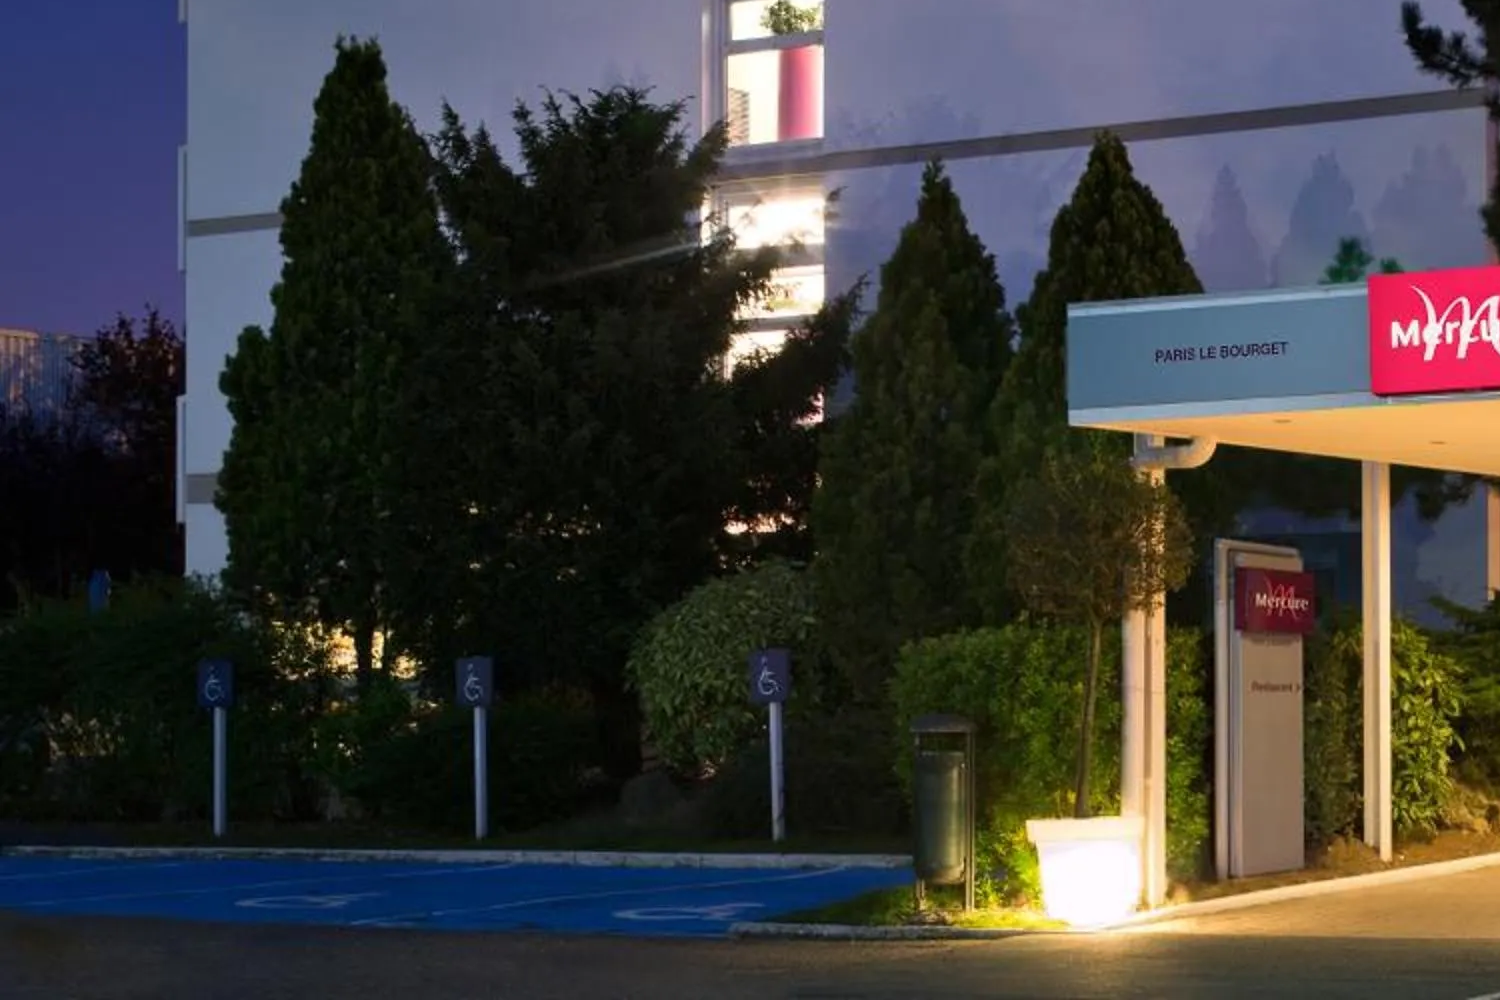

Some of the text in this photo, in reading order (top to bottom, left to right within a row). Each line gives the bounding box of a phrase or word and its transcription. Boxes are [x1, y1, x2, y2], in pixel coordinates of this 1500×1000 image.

[1154, 341, 1290, 363] PARIS LE BOURGET
[1255, 592, 1309, 611] Mercure
